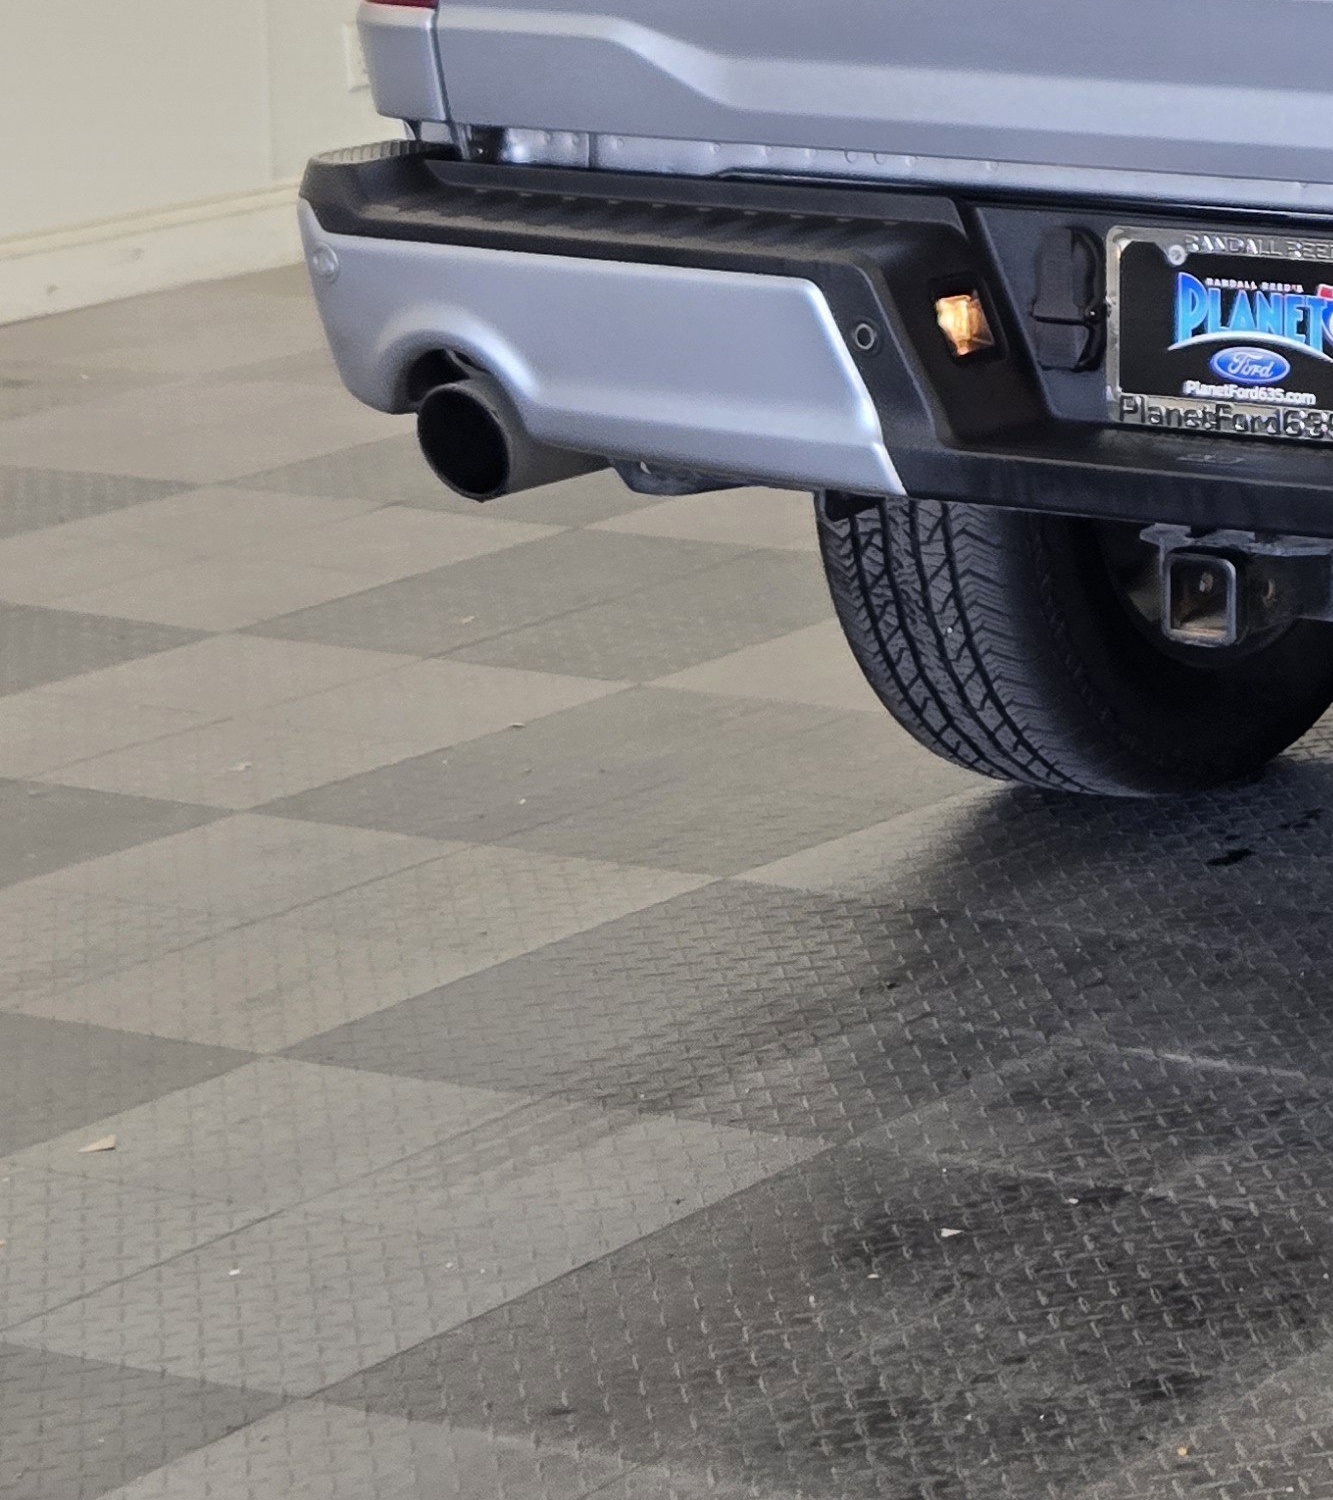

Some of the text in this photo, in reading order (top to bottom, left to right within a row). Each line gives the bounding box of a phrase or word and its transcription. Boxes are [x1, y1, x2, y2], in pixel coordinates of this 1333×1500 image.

[1184, 234, 1282, 257] RANDALL
[1177, 271, 1328, 353] PLANET
[1228, 351, 1275, 380] Ford
[1183, 380, 1317, 406] PlanetFord635.com
